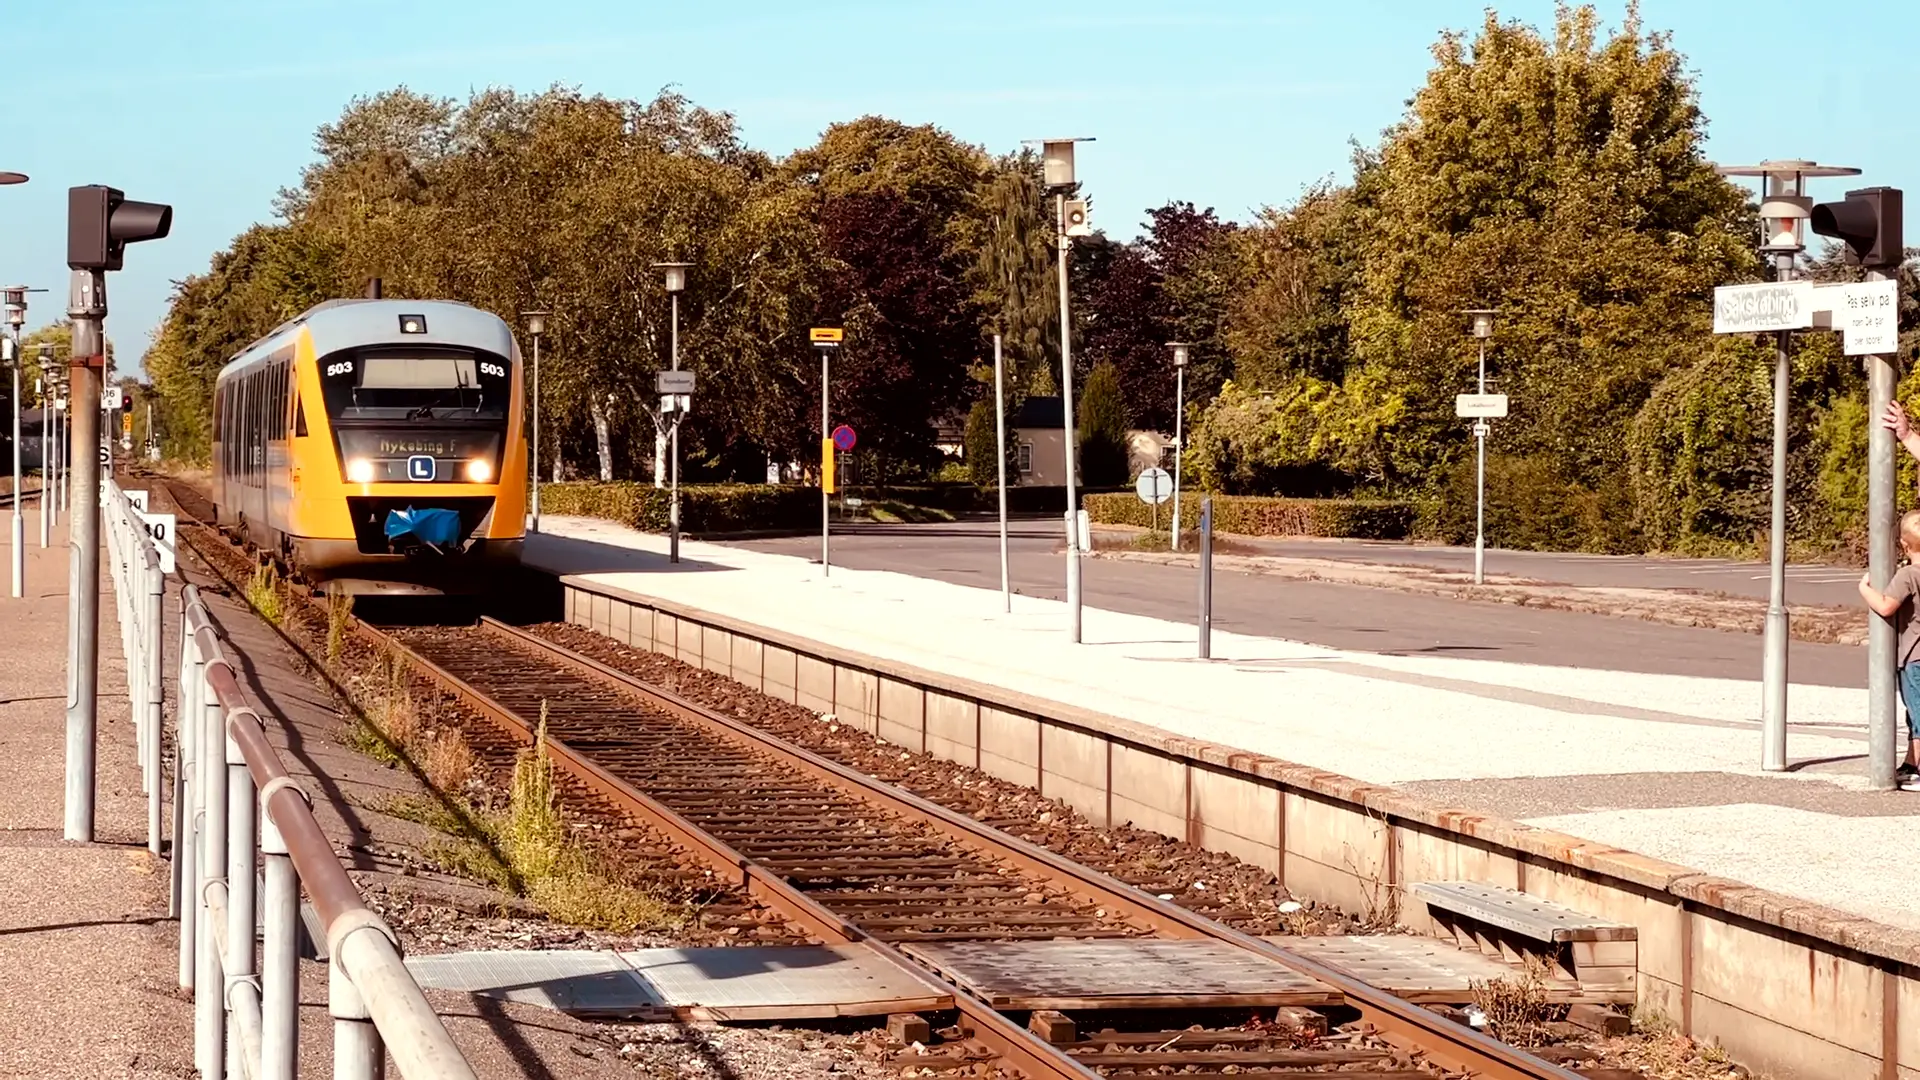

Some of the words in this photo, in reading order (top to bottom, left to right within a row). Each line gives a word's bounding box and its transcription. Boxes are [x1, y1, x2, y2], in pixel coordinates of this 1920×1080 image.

[327, 361, 354, 376] 503
[480, 362, 505, 377] 503
[415, 460, 429, 476] L
